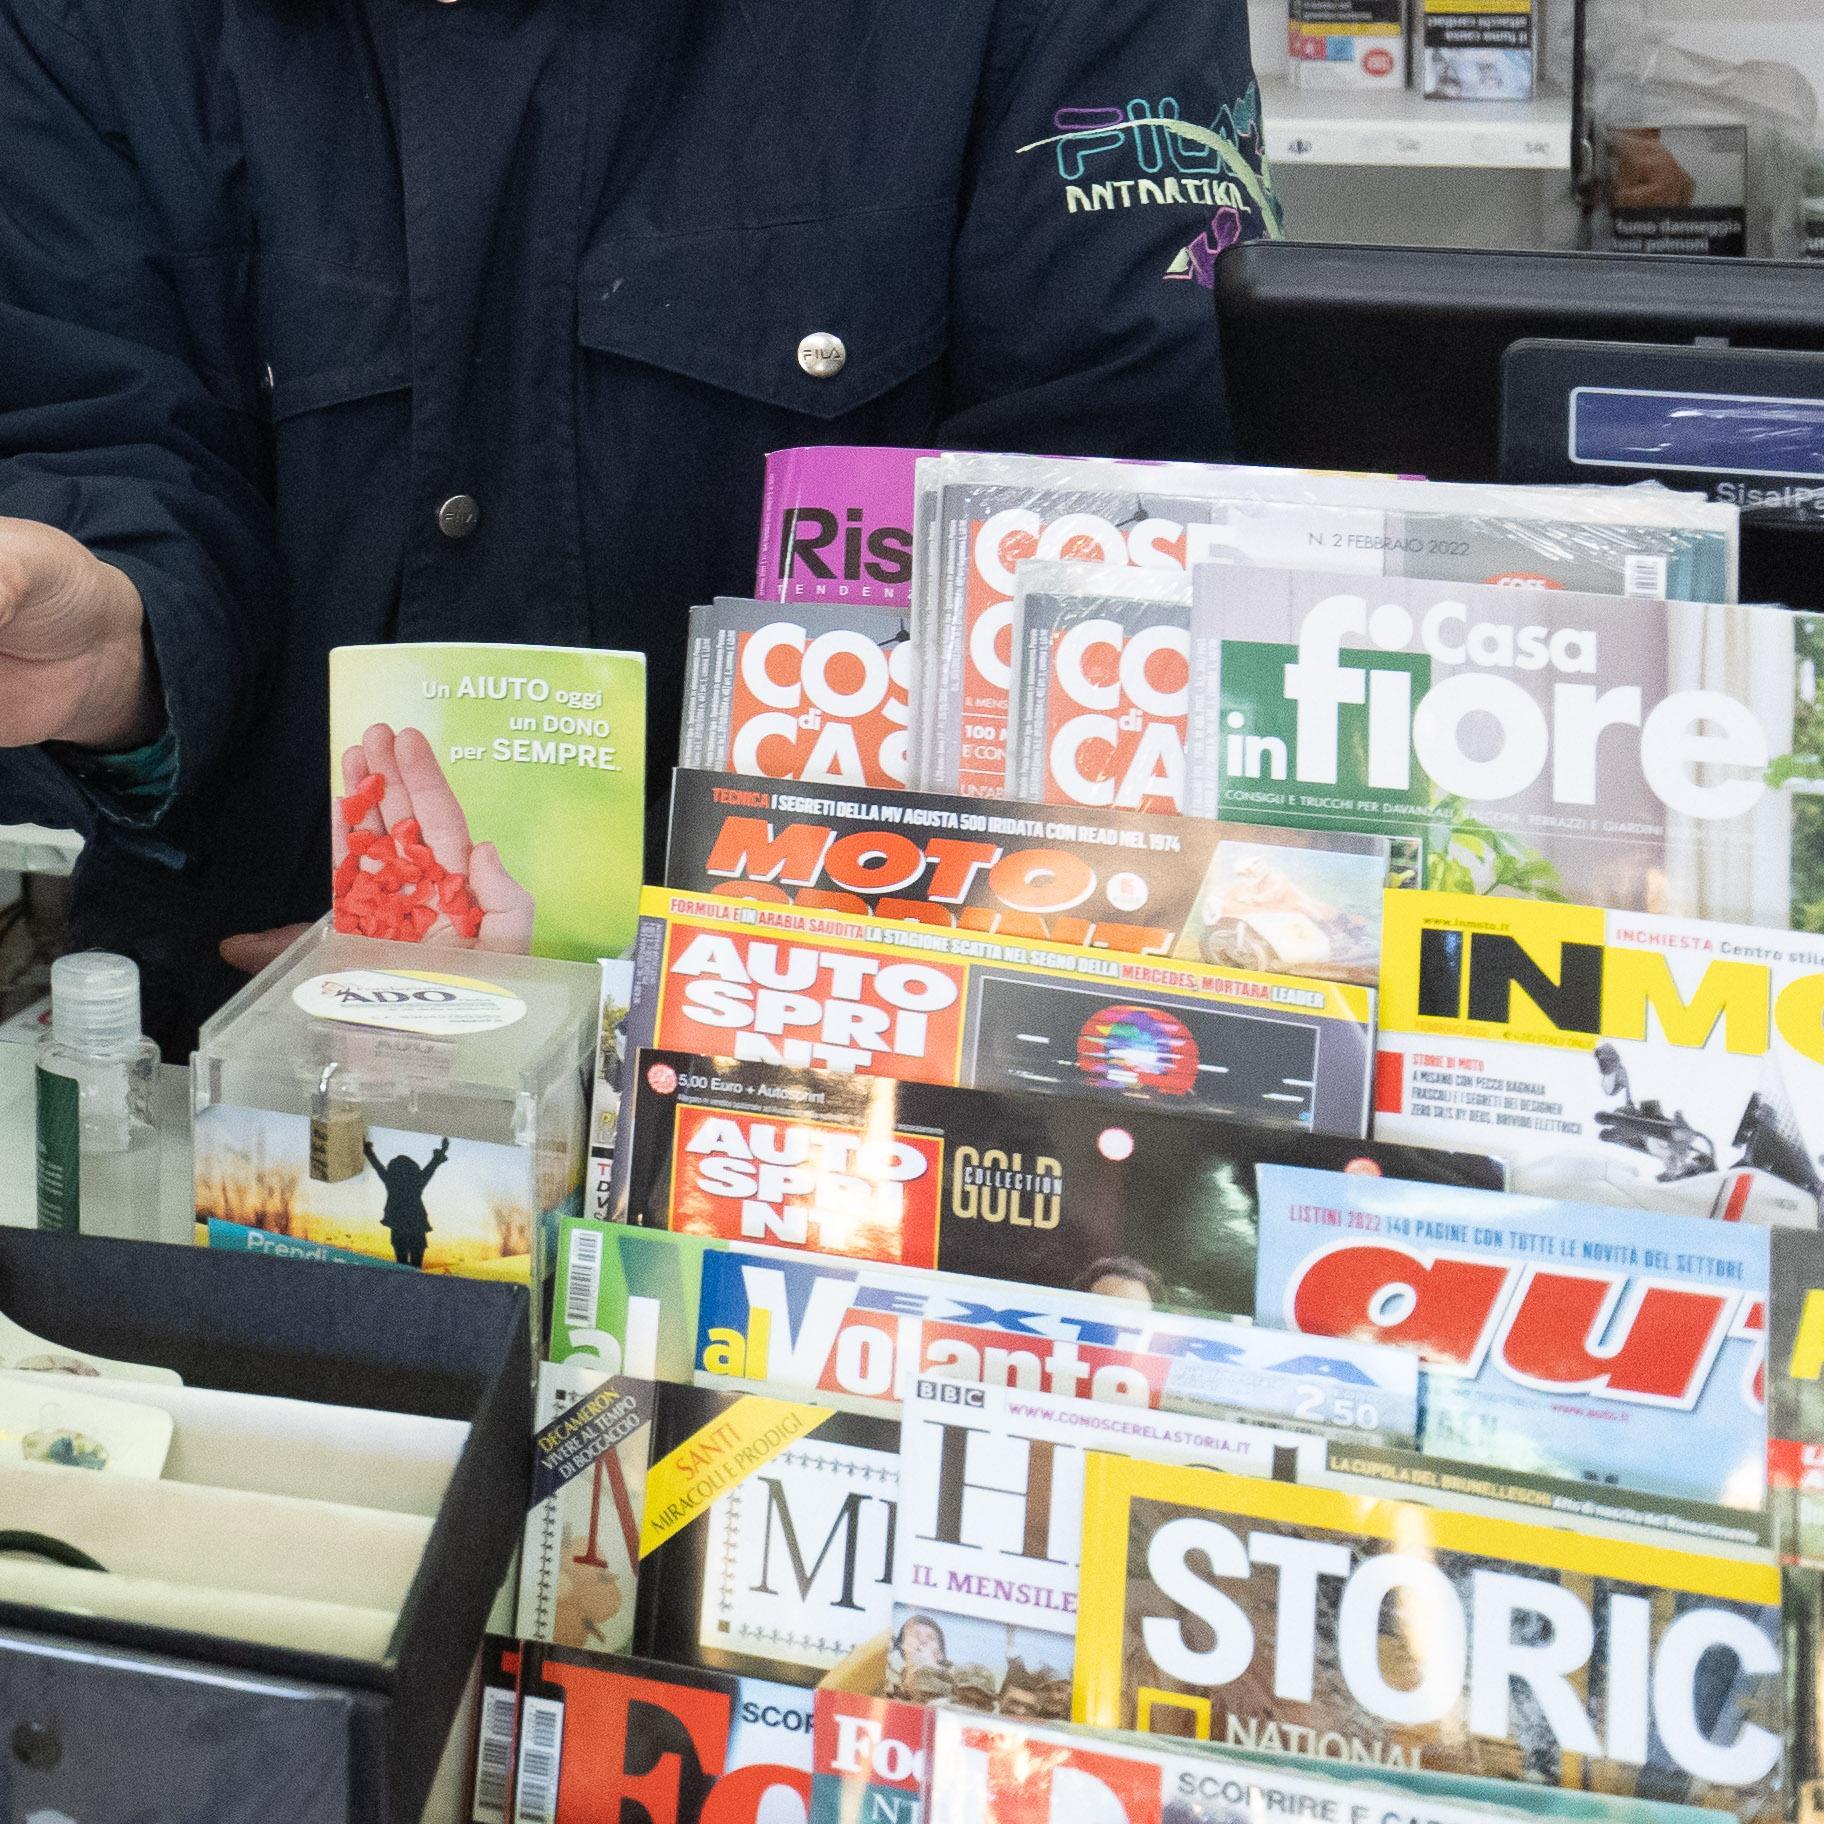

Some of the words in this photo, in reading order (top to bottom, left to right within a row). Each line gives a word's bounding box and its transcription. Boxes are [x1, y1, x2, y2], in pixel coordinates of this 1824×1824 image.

[1332, 533, 1343, 547] 2
[1347, 534, 1423, 554] FEBBRAIO
[1427, 537, 1471, 556] 2022
[1420, 601, 1598, 674] Casa
[422, 679, 451, 700] Un
[456, 677, 550, 702] AIUTO
[554, 688, 604, 711] oggi
[1226, 711, 1288, 781] in
[1283, 594, 1770, 821] fiore
[450, 744, 488, 765] per
[491, 737, 622, 772] SEMPRE.
[509, 716, 537, 733] un
[542, 714, 611, 738] DONO
[777, 795, 837, 818] SEGRETI
[837, 801, 882, 822] DELLA
[904, 806, 959, 830] AGUSTA
[988, 814, 1044, 838] IRIDATA
[1046, 820, 1076, 842] CON
[1077, 824, 1118, 847] READ
[1148, 832, 1181, 854] 1974
[1225, 788, 1284, 806] CONSIGLI
[1298, 795, 1353, 811] TRUCCHI
[706, 815, 1099, 914] MOTO
[671, 931, 958, 1013] AUTO
[1616, 928, 1713, 952] INCHIESTA
[1719, 941, 1783, 962] Centro
[679, 975, 929, 1060] SPRI
[678, 1070, 710, 1090] 5,00
[711, 1075, 742, 1094] Euro
[756, 1081, 825, 1106] Autosprint
[684, 1116, 929, 1183] AUTO
[697, 1155, 906, 1221] SPRI
[952, 1143, 1064, 1231] GOLD
[964, 1164, 1064, 1196] COLLECTION
[246, 1229, 328, 1264] Prendi
[738, 1197, 853, 1250] NT
[1289, 1203, 1342, 1228] LISTINI
[1347, 1210, 1381, 1232] 2022
[1415, 1219, 1469, 1244] PAGINE
[1473, 1225, 1504, 1247] CON
[1510, 1231, 1554, 1255] TUTTE
[1582, 1237, 1638, 1266] NOVITÀ
[1644, 1248, 1670, 1272] DEL
[1676, 1252, 1745, 1280] SETTORE
[704, 1306, 768, 1378] al
[538, 1388, 621, 1453] DECAMERON
[916, 1379, 986, 1409] BBC
[573, 1413, 641, 1467] BOCCACCIO
[676, 1422, 743, 1481] SANTI
[736, 1411, 803, 1472] PRODIGI
[1007, 1399, 1252, 1456] WWW.CONOSCERELASTORIA.IT
[911, 1564, 939, 1590] IL
[946, 1570, 1078, 1614] MENSILE
[1141, 1516, 1783, 1788] STORIC
